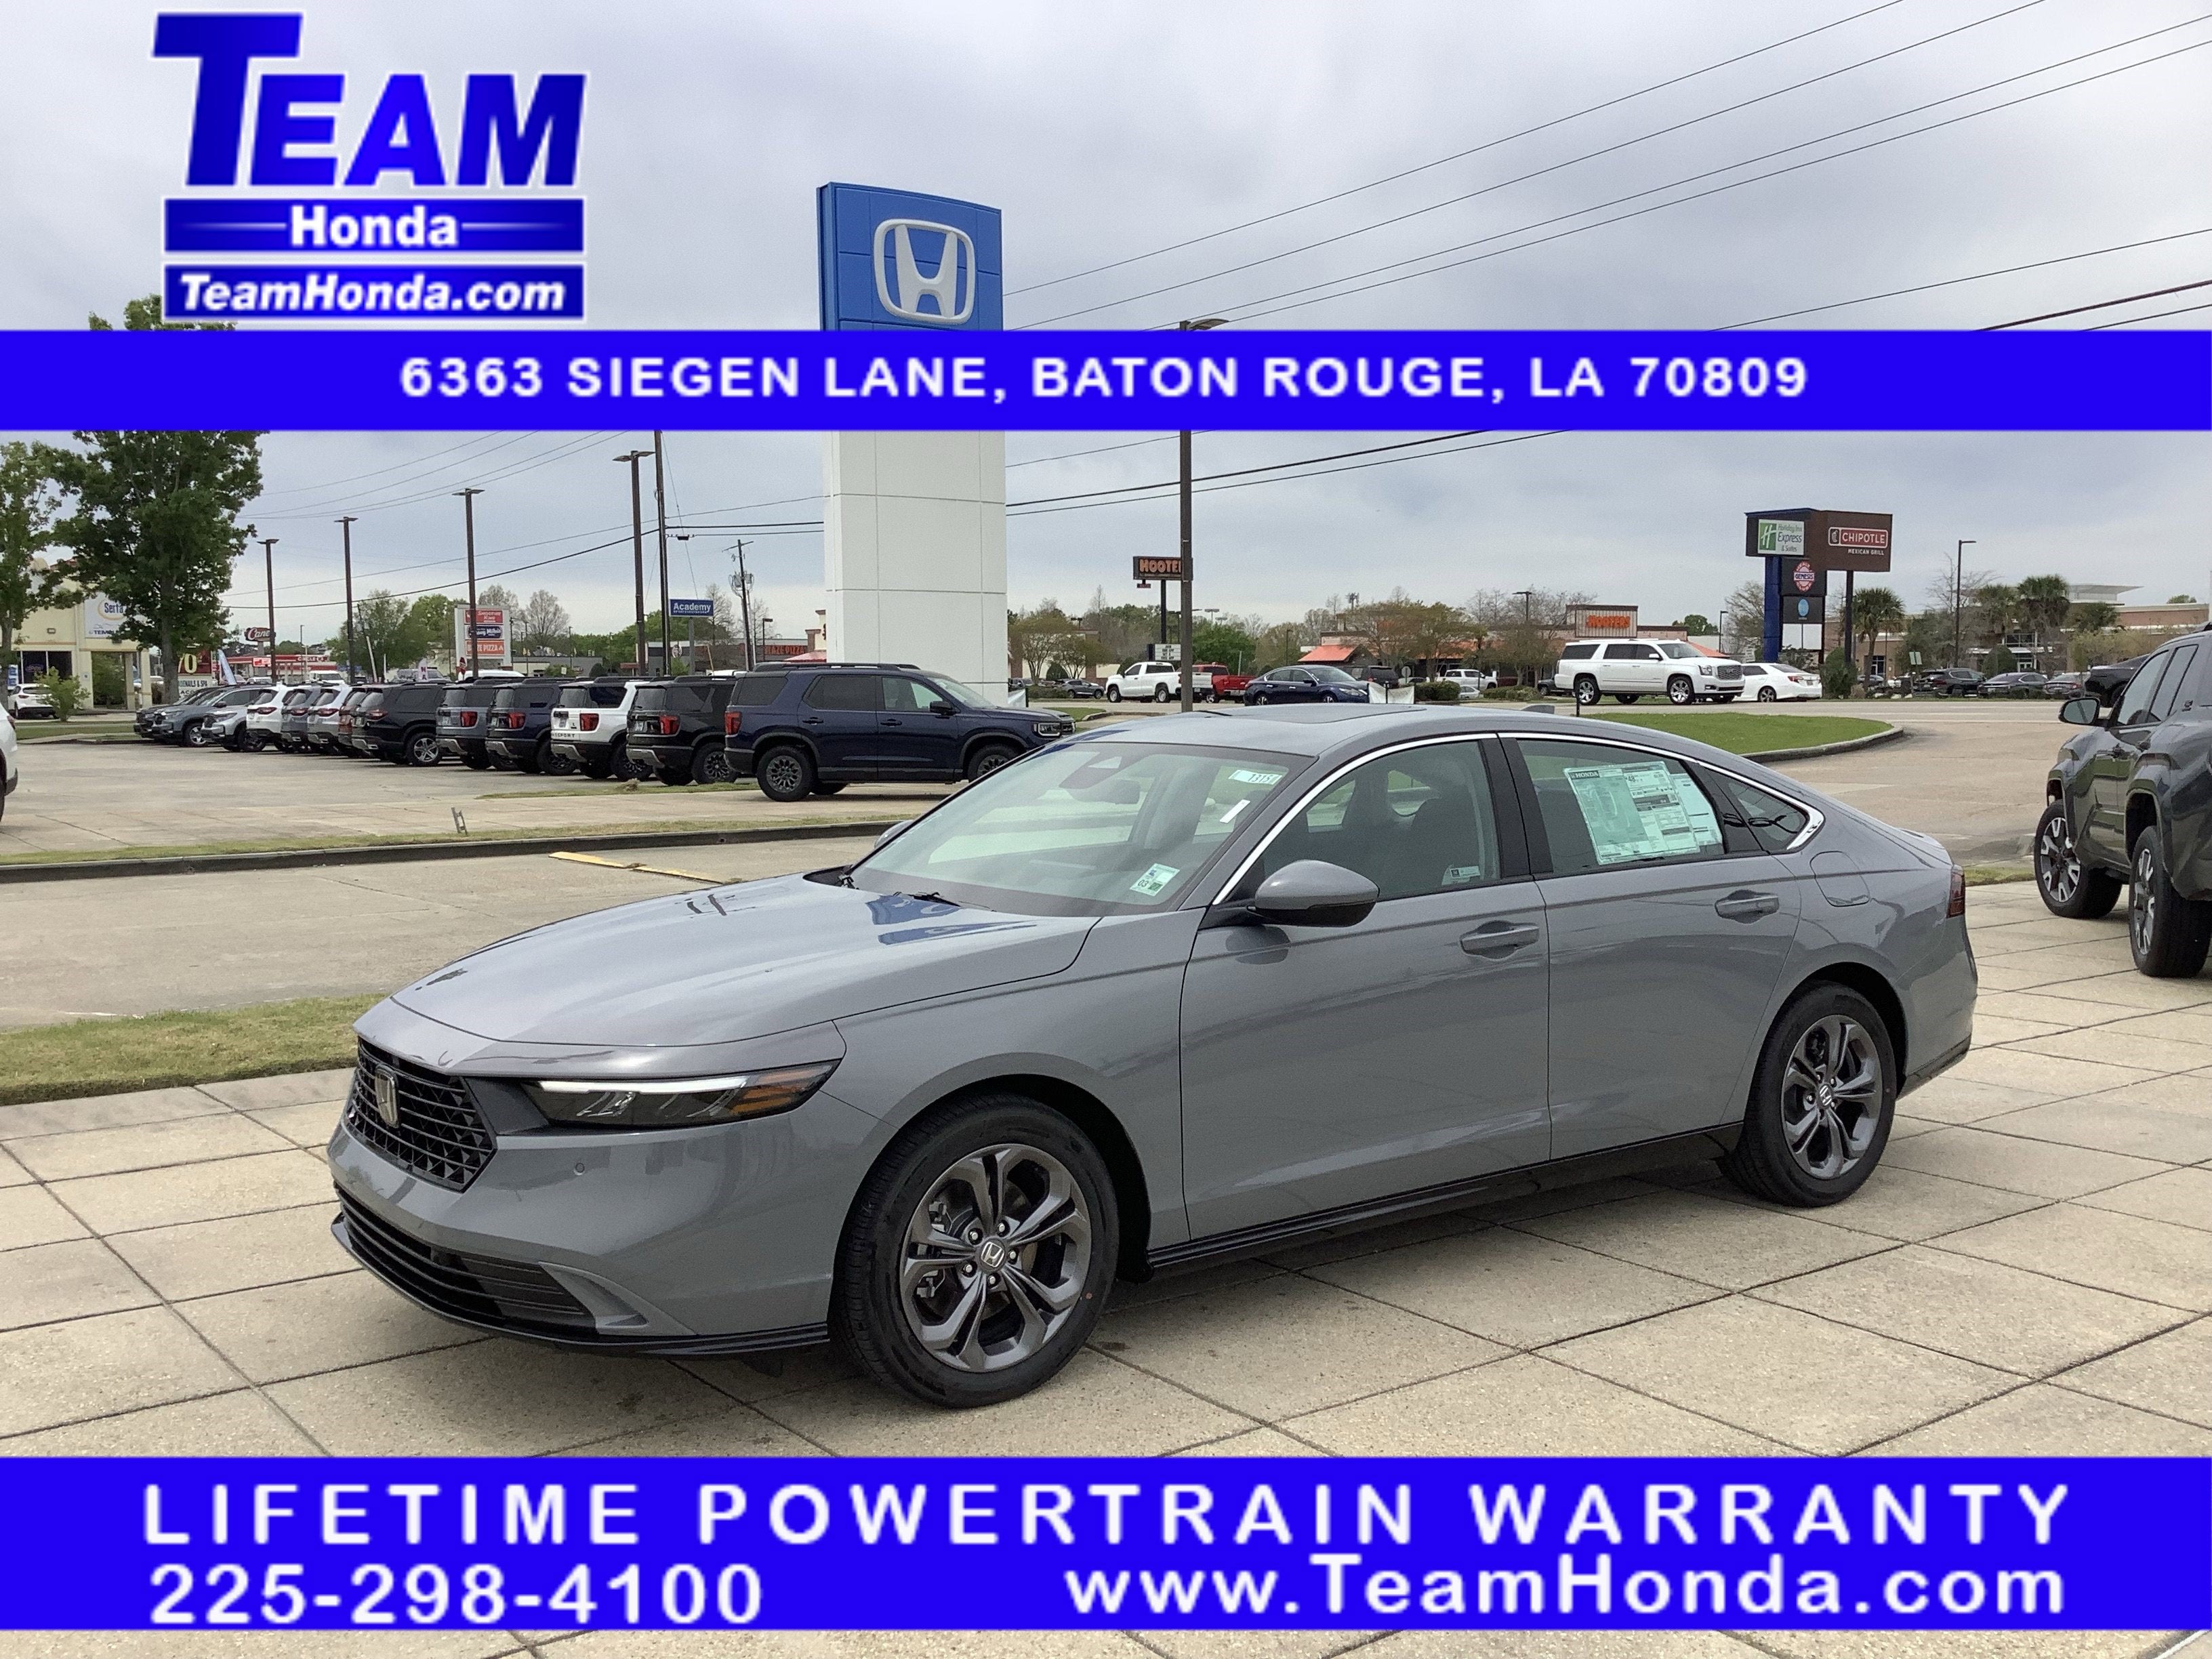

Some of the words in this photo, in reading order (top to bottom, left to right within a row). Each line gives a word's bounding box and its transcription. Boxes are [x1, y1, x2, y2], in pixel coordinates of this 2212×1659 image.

[1778, 532, 1802, 544] Express
[1842, 532, 1885, 544] CHIPOTLE
[104, 602, 124, 613] Serta
[674, 602, 711, 613] Academy
[247, 628, 271, 640] Cane
[1575, 771, 1599, 779] HONDA
[1137, 879, 1149, 887] 03
